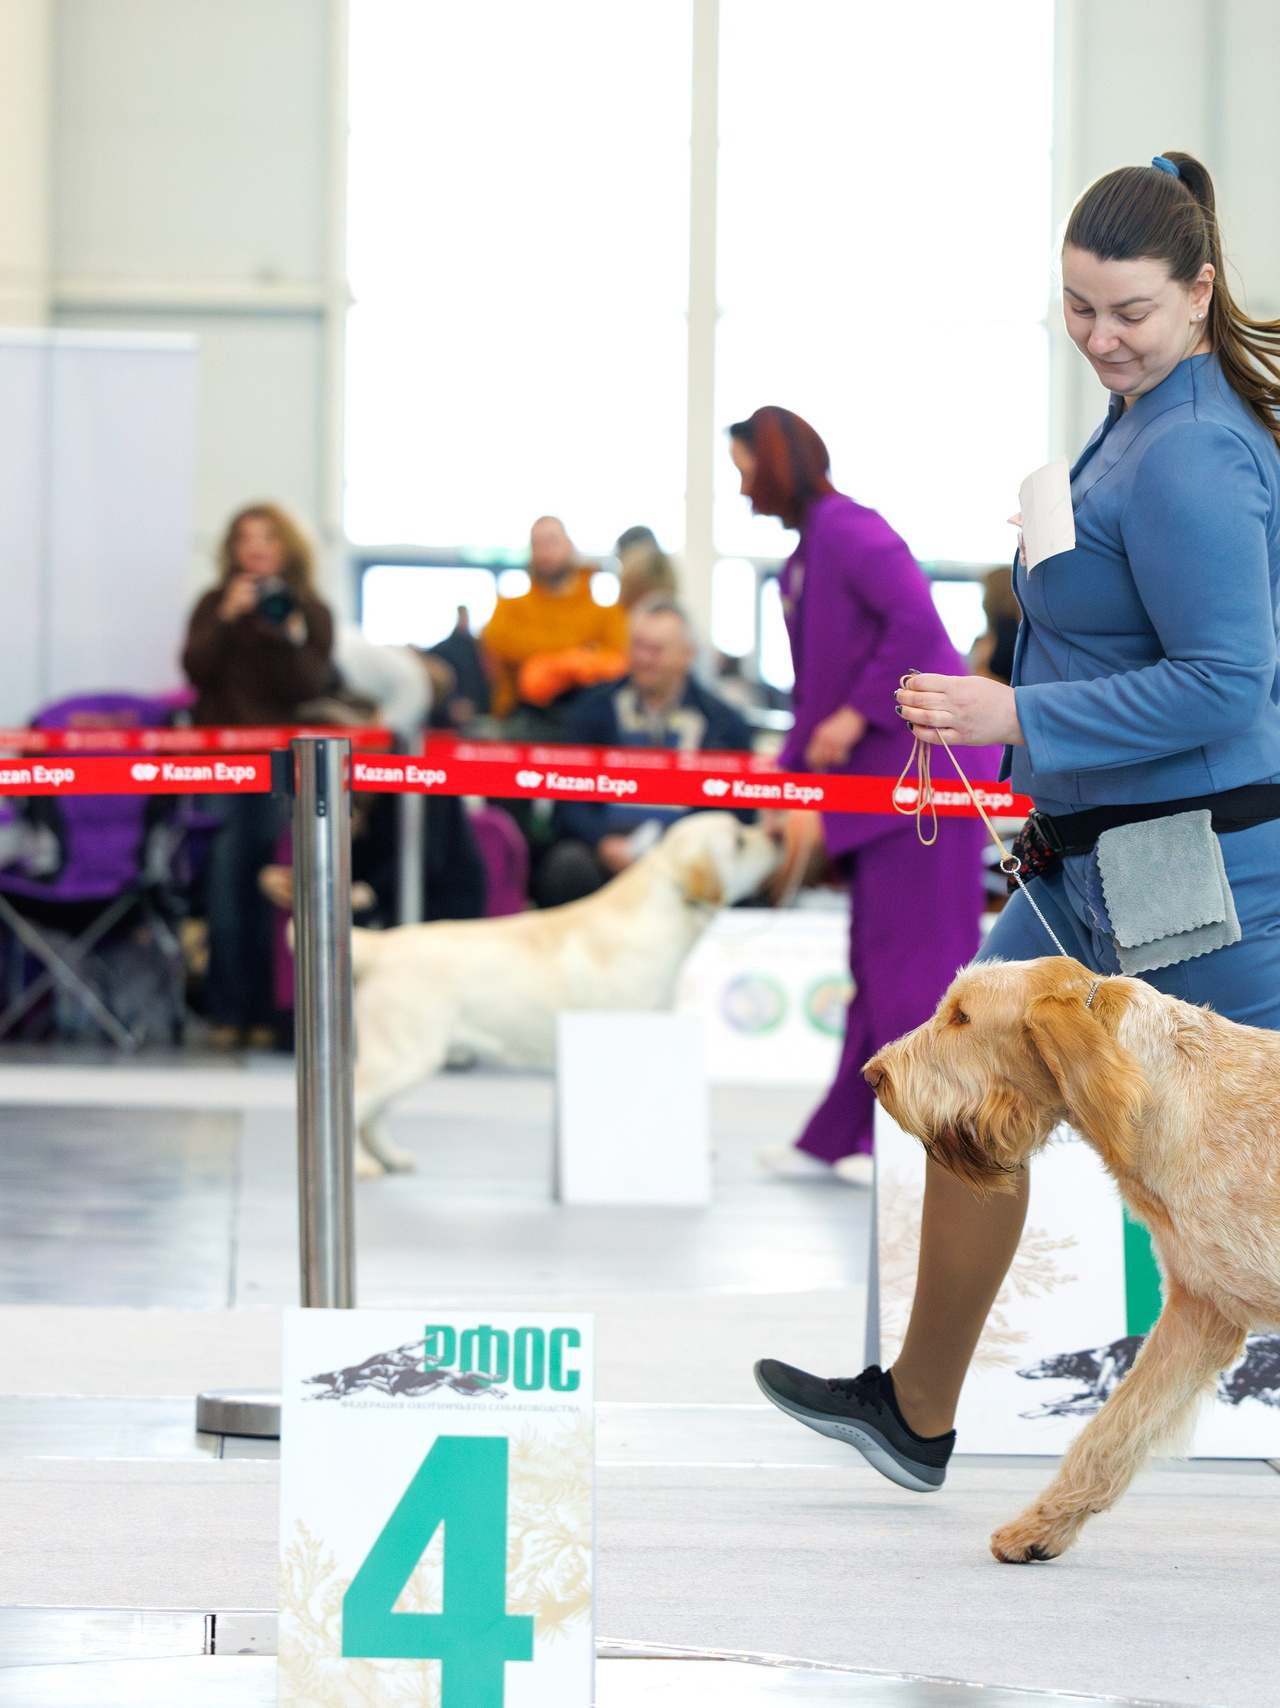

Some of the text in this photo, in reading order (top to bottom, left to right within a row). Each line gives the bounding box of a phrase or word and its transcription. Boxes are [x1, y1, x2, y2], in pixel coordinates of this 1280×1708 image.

[33, 765, 74, 787] Expo
[162, 762, 256, 785] Kazan Expo
[354, 763, 446, 787] Kazan Expo
[546, 772, 638, 797] Kazan Expo
[733, 780, 824, 805] Kazan Expo
[425, 1323, 581, 1392] РФОС
[342, 1435, 534, 1708] 4
